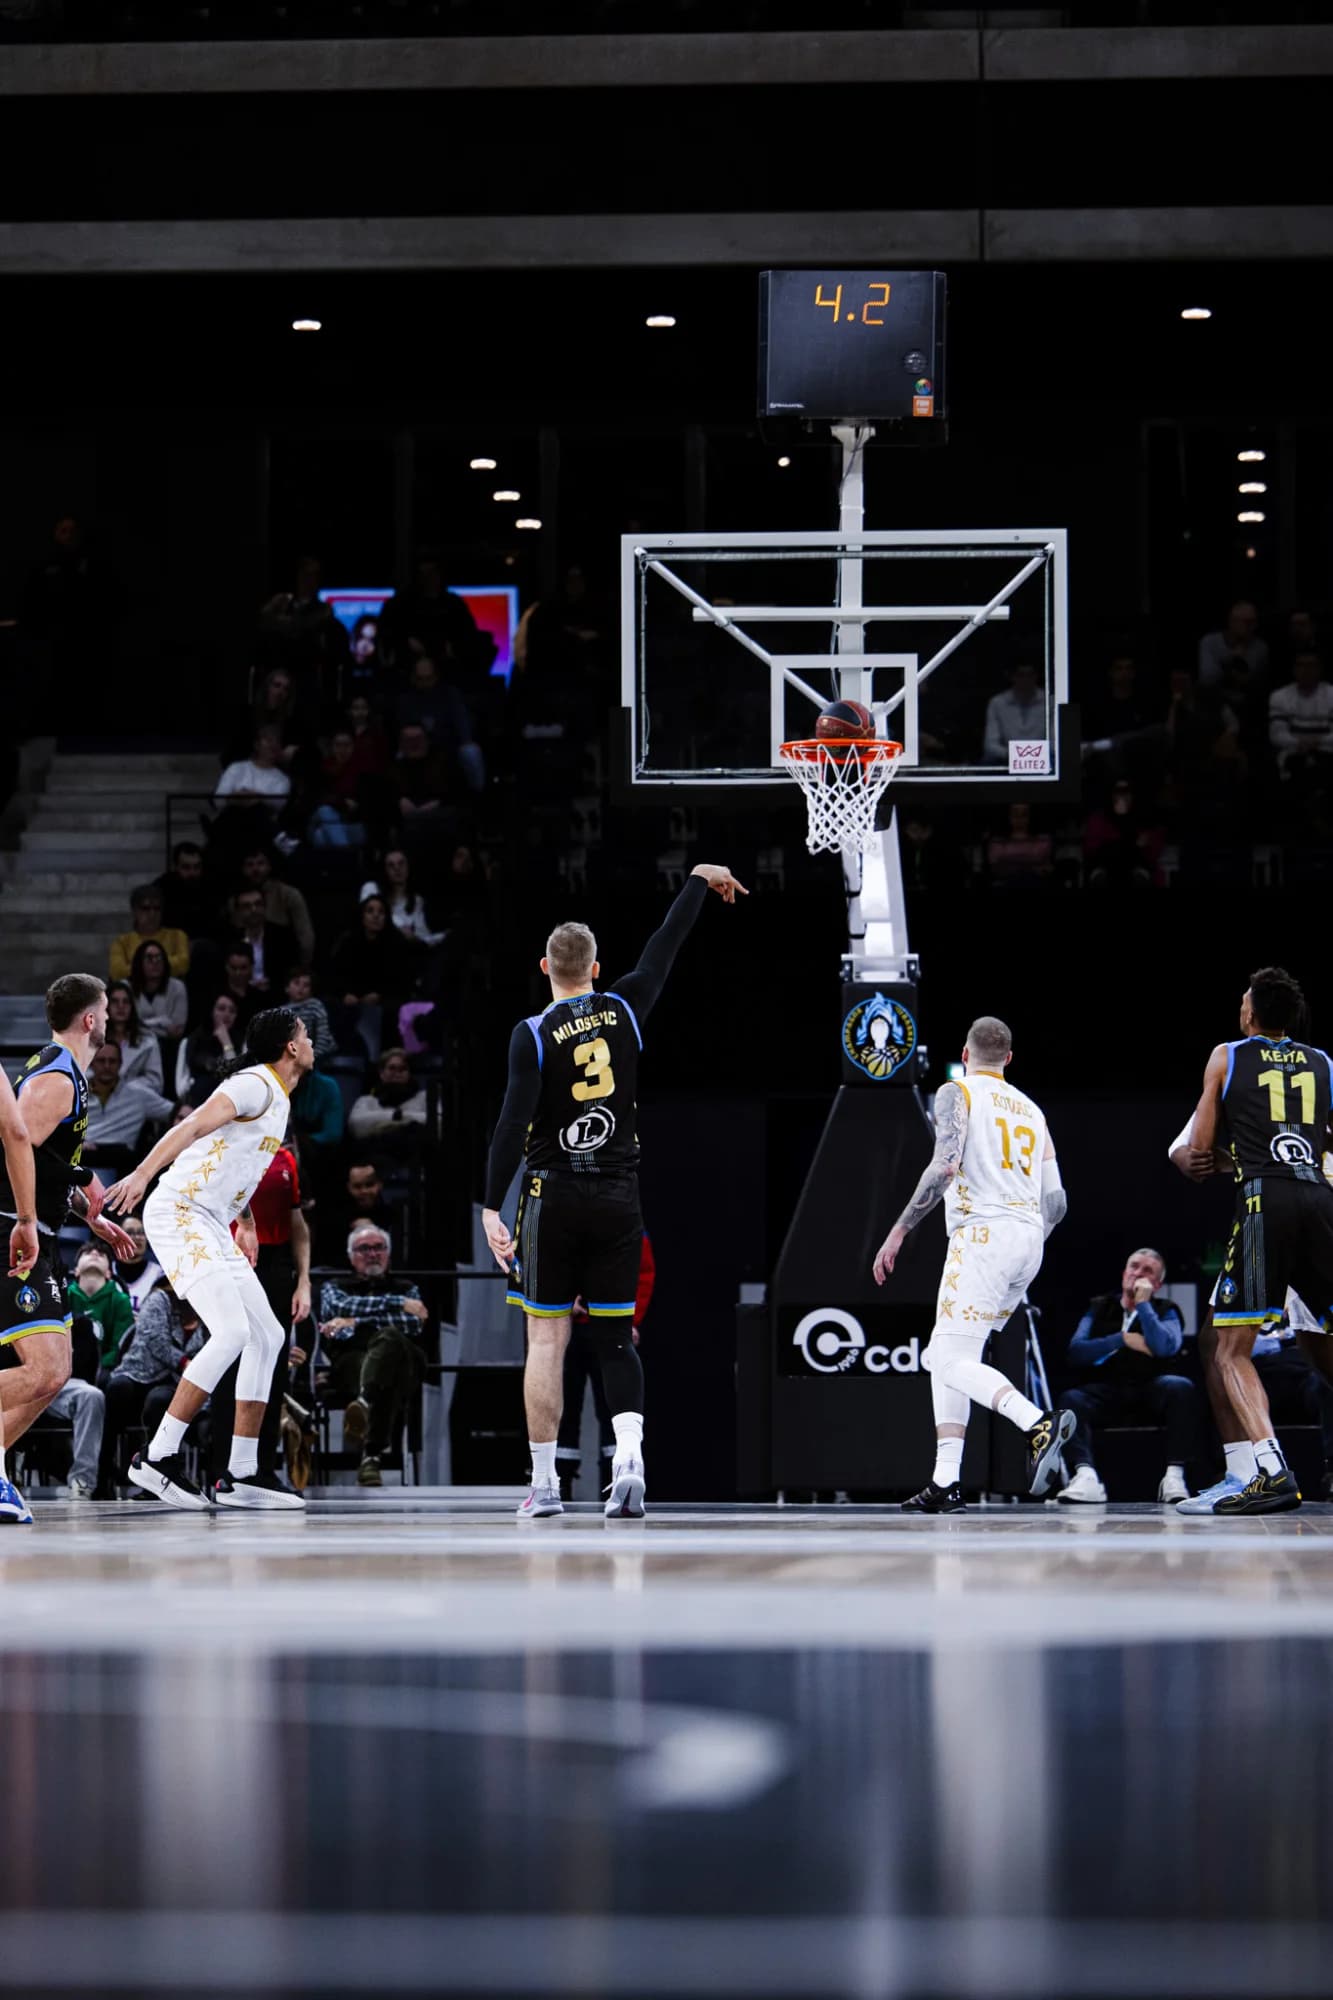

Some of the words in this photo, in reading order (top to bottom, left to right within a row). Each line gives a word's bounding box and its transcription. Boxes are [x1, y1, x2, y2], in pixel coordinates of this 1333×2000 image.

[815, 283, 891, 325] 4.2
[571, 1037, 615, 1102] 3
[1260, 1049, 1307, 1064] KEITA
[1257, 1068, 1316, 1125] 11
[994, 1117, 1037, 1177] 13
[529, 1177, 542, 1198] 3
[1245, 1194, 1262, 1214] 11
[970, 1226, 990, 1244] 13
